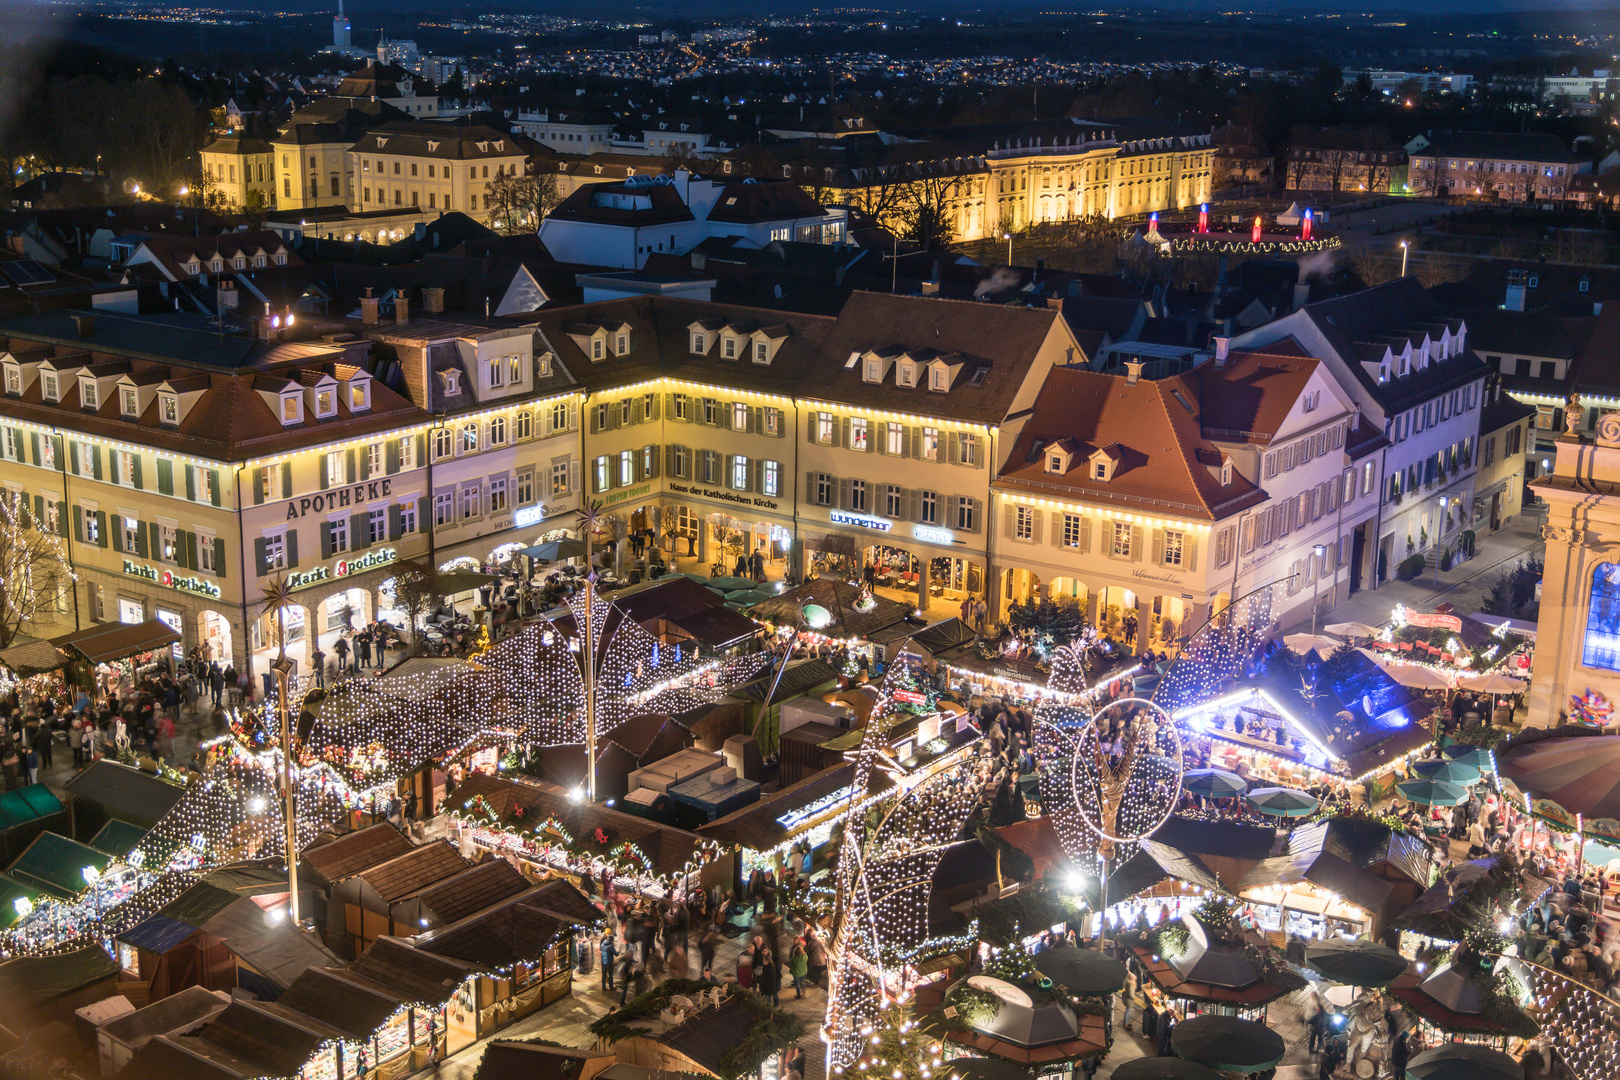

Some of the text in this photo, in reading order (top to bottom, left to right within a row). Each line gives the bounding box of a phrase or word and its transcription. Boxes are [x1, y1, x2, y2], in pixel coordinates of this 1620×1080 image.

[286, 479, 391, 520] APOTHEKE
[606, 490, 628, 504] FROZEN
[629, 484, 651, 498] YOGURT
[670, 483, 778, 509] Haus der Katholischen Kirche
[123, 560, 219, 597] Markt Apotheke
[290, 550, 397, 587] Markt Apotheke
